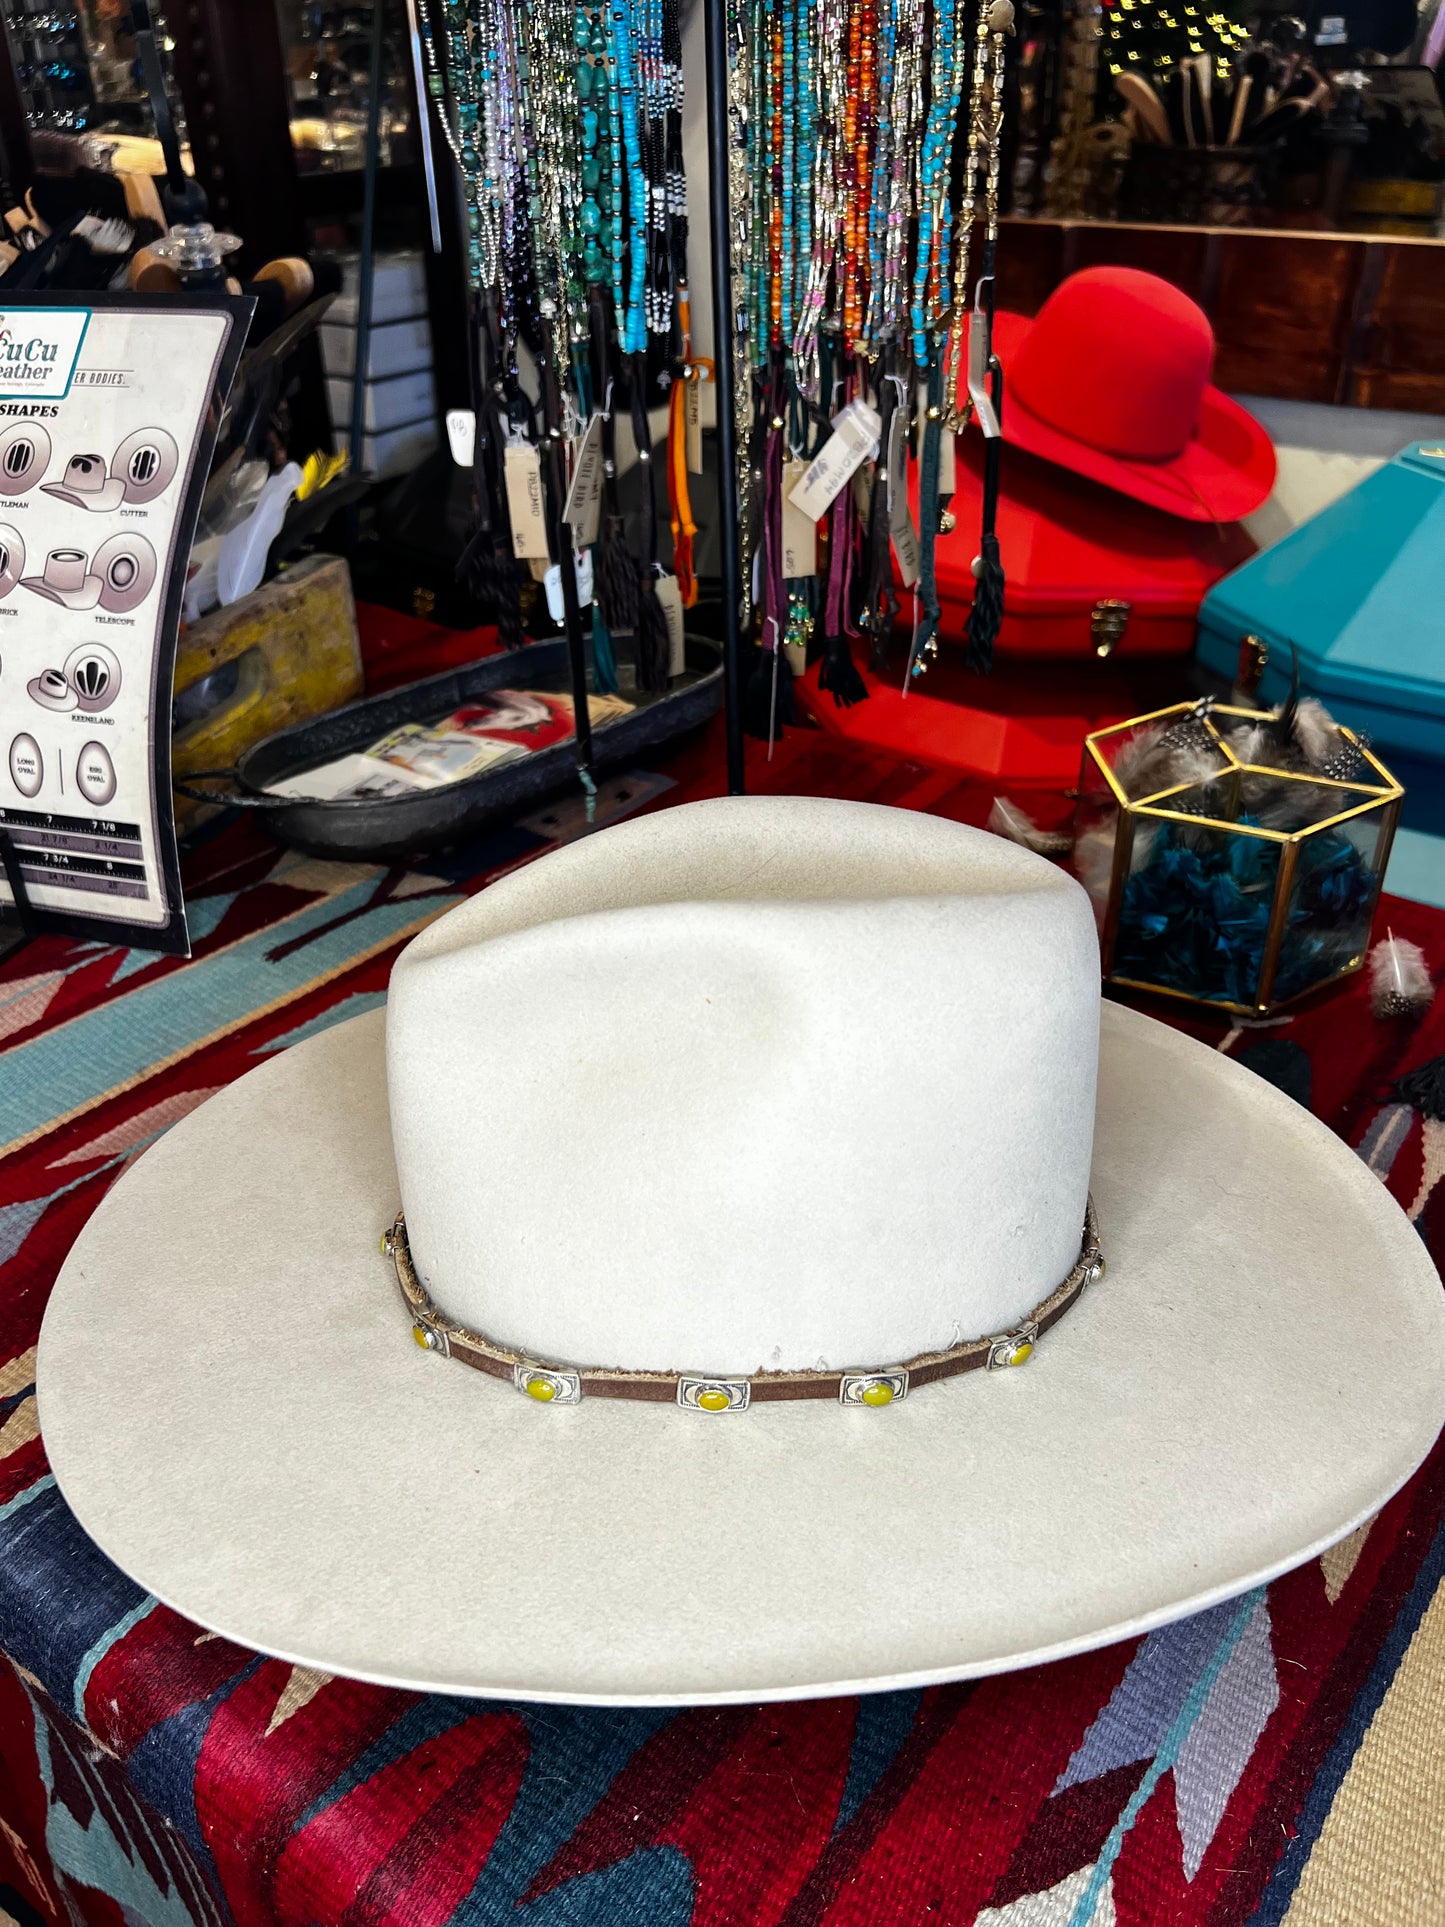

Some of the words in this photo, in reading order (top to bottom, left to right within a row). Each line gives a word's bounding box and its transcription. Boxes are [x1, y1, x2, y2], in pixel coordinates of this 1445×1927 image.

[0, 404, 59, 418] SHAPES
[95, 616, 136, 626] TELESCOPE
[71, 715, 115, 726] KEENELAND
[17, 758, 34, 766] LONG
[18, 767, 35, 775] OVAL
[87, 775, 105, 783] OVAL
[46, 815, 53, 823] 7
[92, 820, 98, 829] 7
[102, 822, 116, 832] 1/8
[43, 853, 49, 861] 7
[53, 855, 69, 864] 3/4
